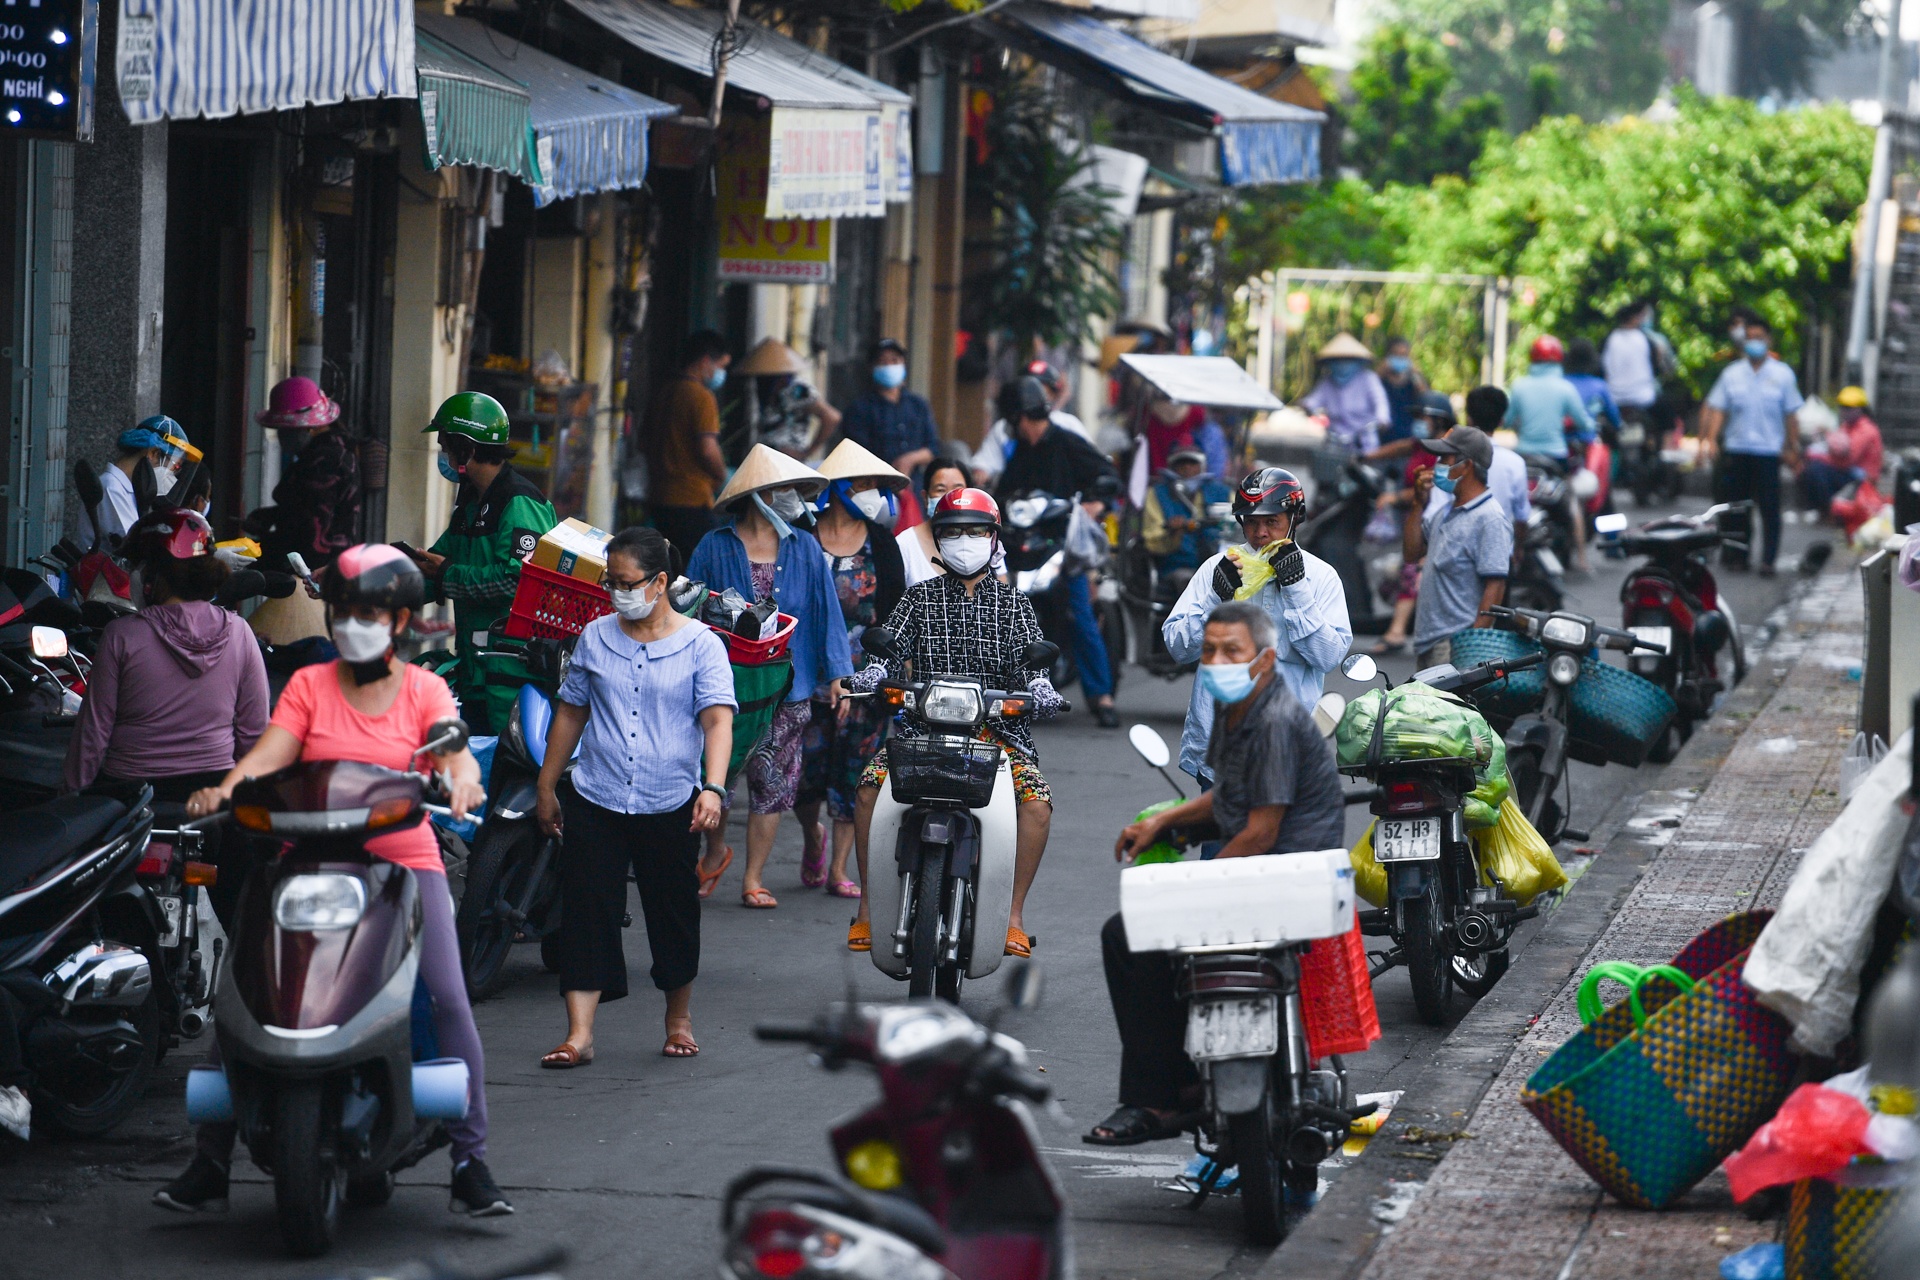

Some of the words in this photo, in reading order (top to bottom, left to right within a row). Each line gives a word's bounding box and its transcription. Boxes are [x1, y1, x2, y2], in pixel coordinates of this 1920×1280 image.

[4, 76, 43, 98] NGHỈ
[1384, 821, 1430, 839] 52-H3
[1384, 839, 1429, 858] 3141
